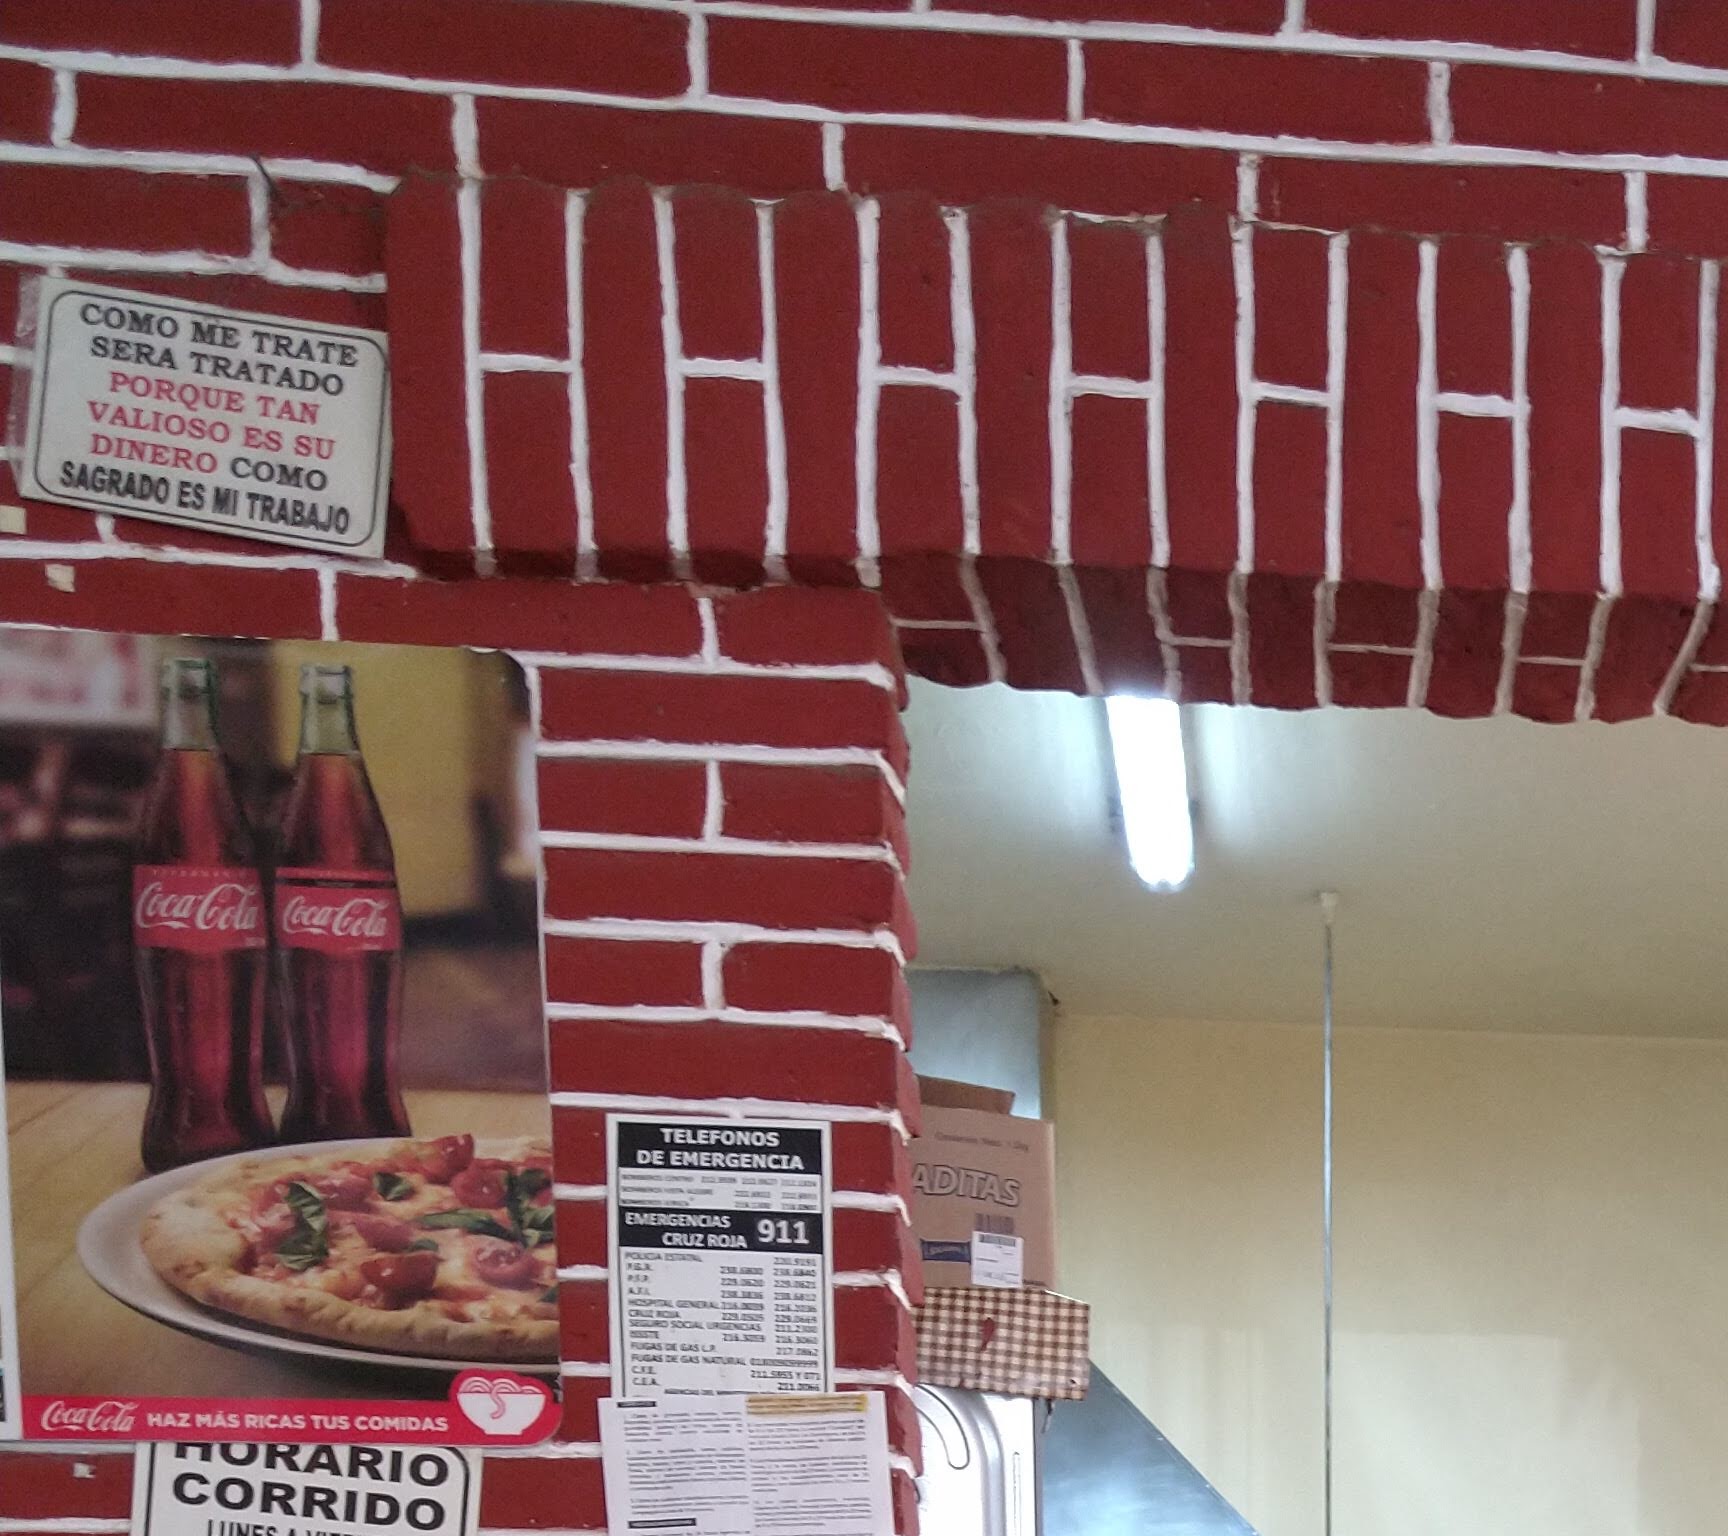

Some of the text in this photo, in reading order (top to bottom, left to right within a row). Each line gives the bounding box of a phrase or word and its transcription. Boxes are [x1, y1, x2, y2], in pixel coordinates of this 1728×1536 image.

[80, 303, 357, 367] COMO ME TRATE
[90, 337, 343, 396] SERA TRATADO
[109, 371, 319, 425] PORQUE TAN
[87, 401, 335, 459] VALIOSO ES SU
[90, 434, 327, 491] DINERO COMO
[60, 461, 349, 534] SAGRADO ES MI TRABAJO
[636, 1150, 804, 1170] DE EMERGENCIA
[660, 1127, 780, 1147] TELEFONOS
[625, 1212, 810, 1245] EMERGENCIAS 911
[662, 1232, 748, 1249] CRUZ ROJA
[147, 1411, 448, 1432] HAZ MÁS RICAS TUS COMIDAS
[172, 1472, 445, 1531] CORRIDO
